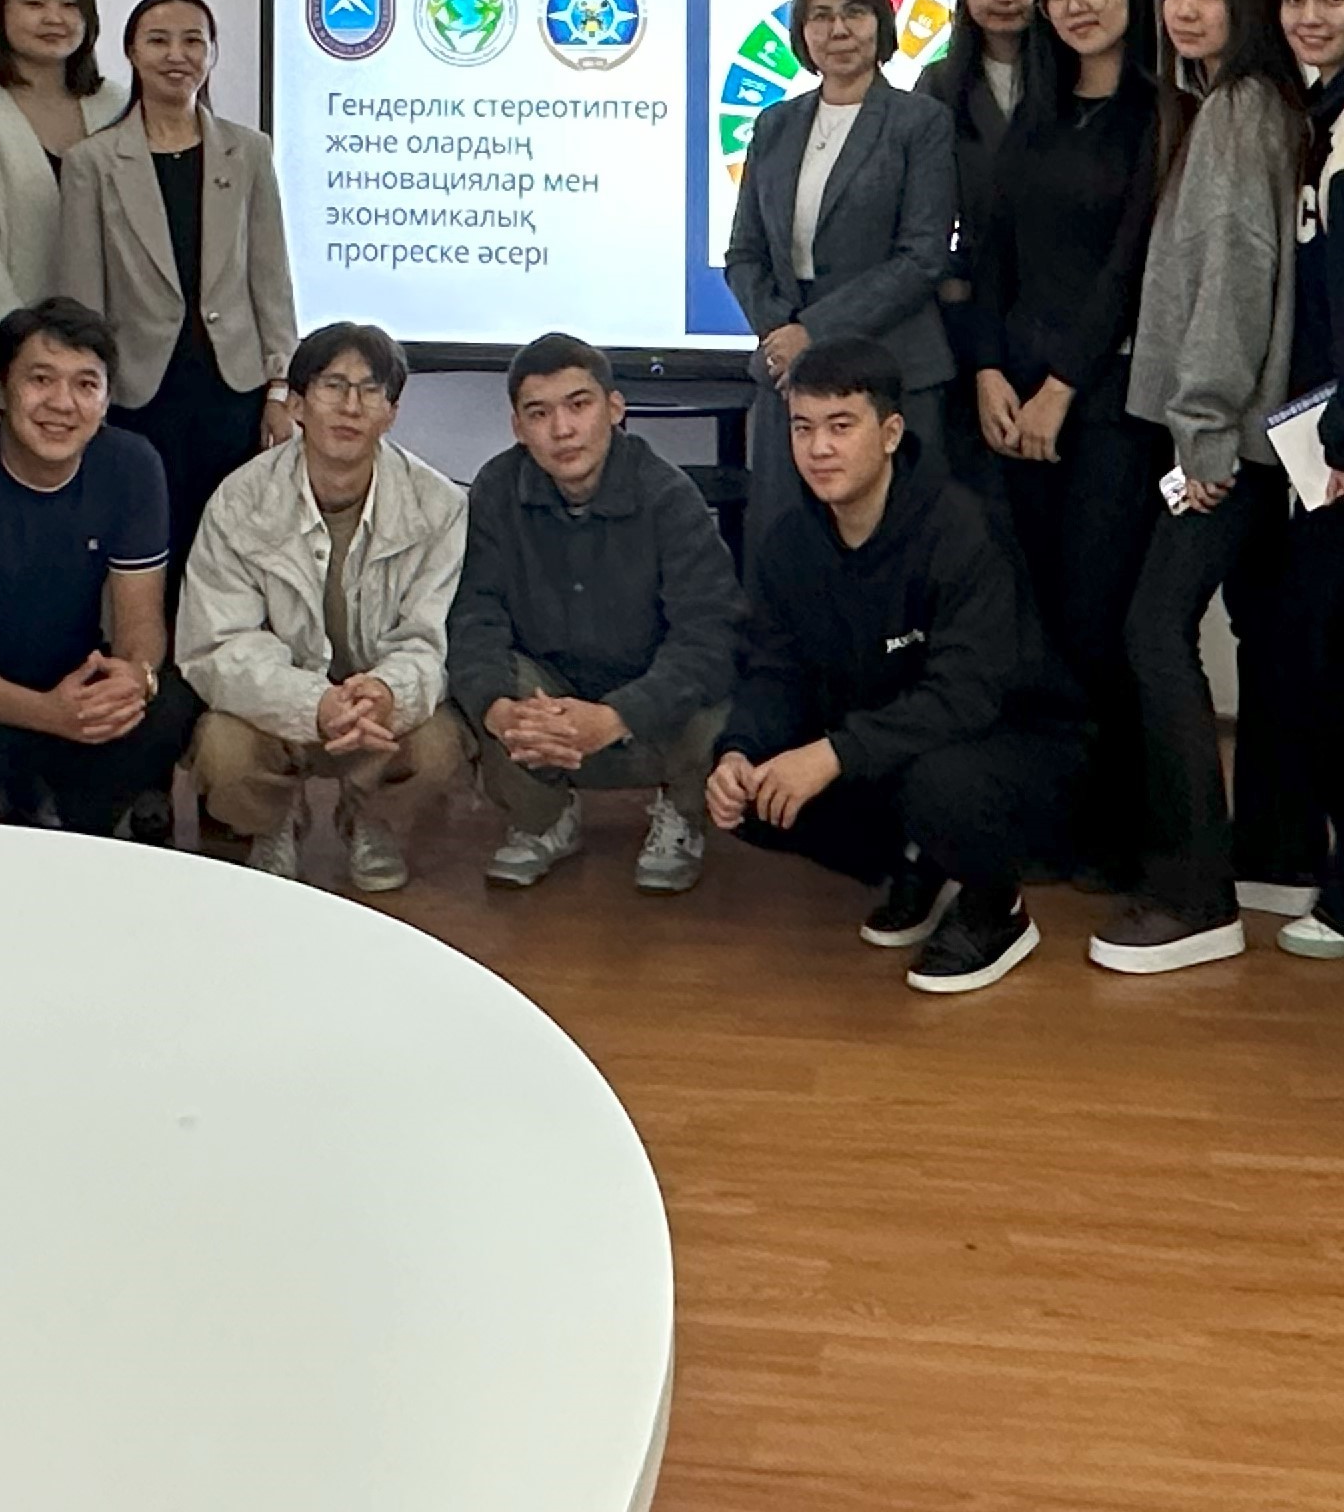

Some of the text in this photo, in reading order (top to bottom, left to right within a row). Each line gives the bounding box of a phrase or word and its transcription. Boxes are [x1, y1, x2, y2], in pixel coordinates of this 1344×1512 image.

[327, 92, 668, 126] Гендерлік стереотиптер
[325, 133, 534, 162] және олардың
[326, 170, 599, 199] инновациялар мен
[325, 206, 536, 235] экономикалық
[326, 242, 549, 273] прогреске әсері
